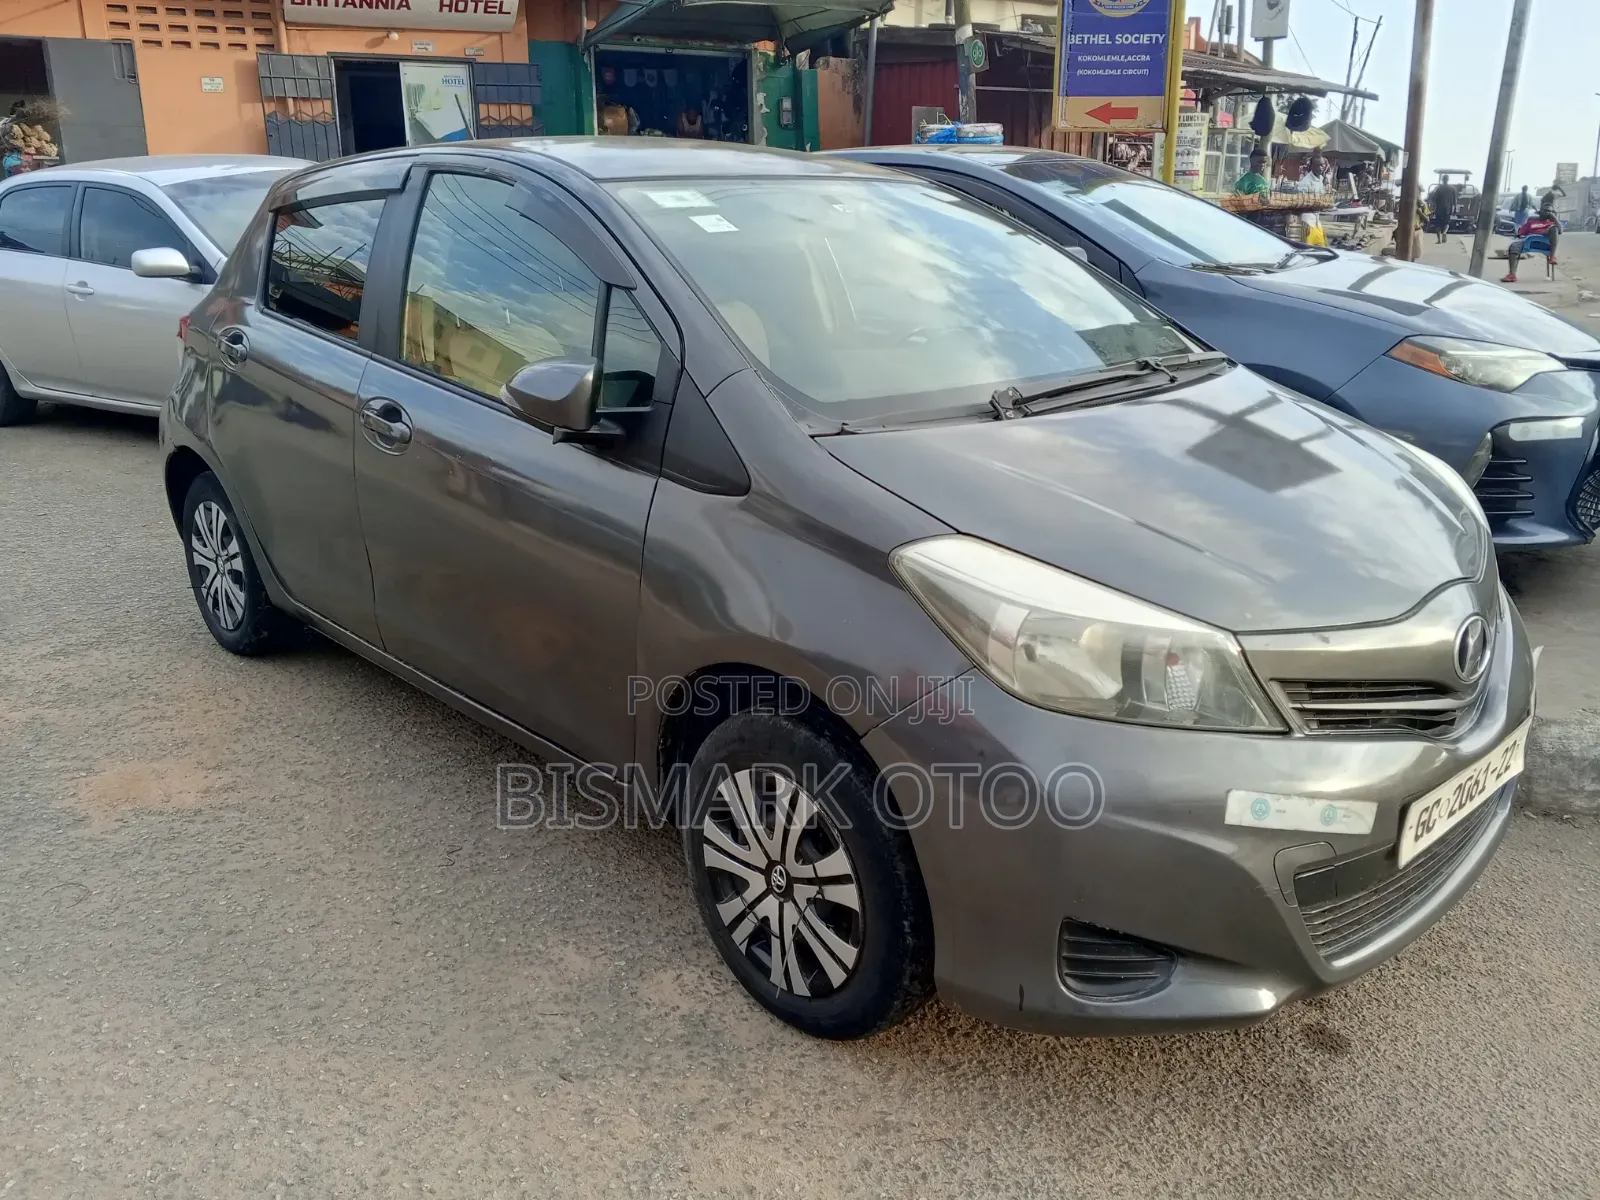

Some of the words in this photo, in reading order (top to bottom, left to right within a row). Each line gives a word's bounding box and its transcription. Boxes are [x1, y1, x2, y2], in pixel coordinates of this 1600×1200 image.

[439, 0, 511, 14] HOTEL
[1068, 33, 1112, 45] BETHEL
[1115, 33, 1166, 45] SOCIETY
[1076, 68, 1122, 76] (KOKOMLEMLE
[1122, 68, 1150, 76] CIRCUIT)
[1414, 797, 1442, 842] GC
